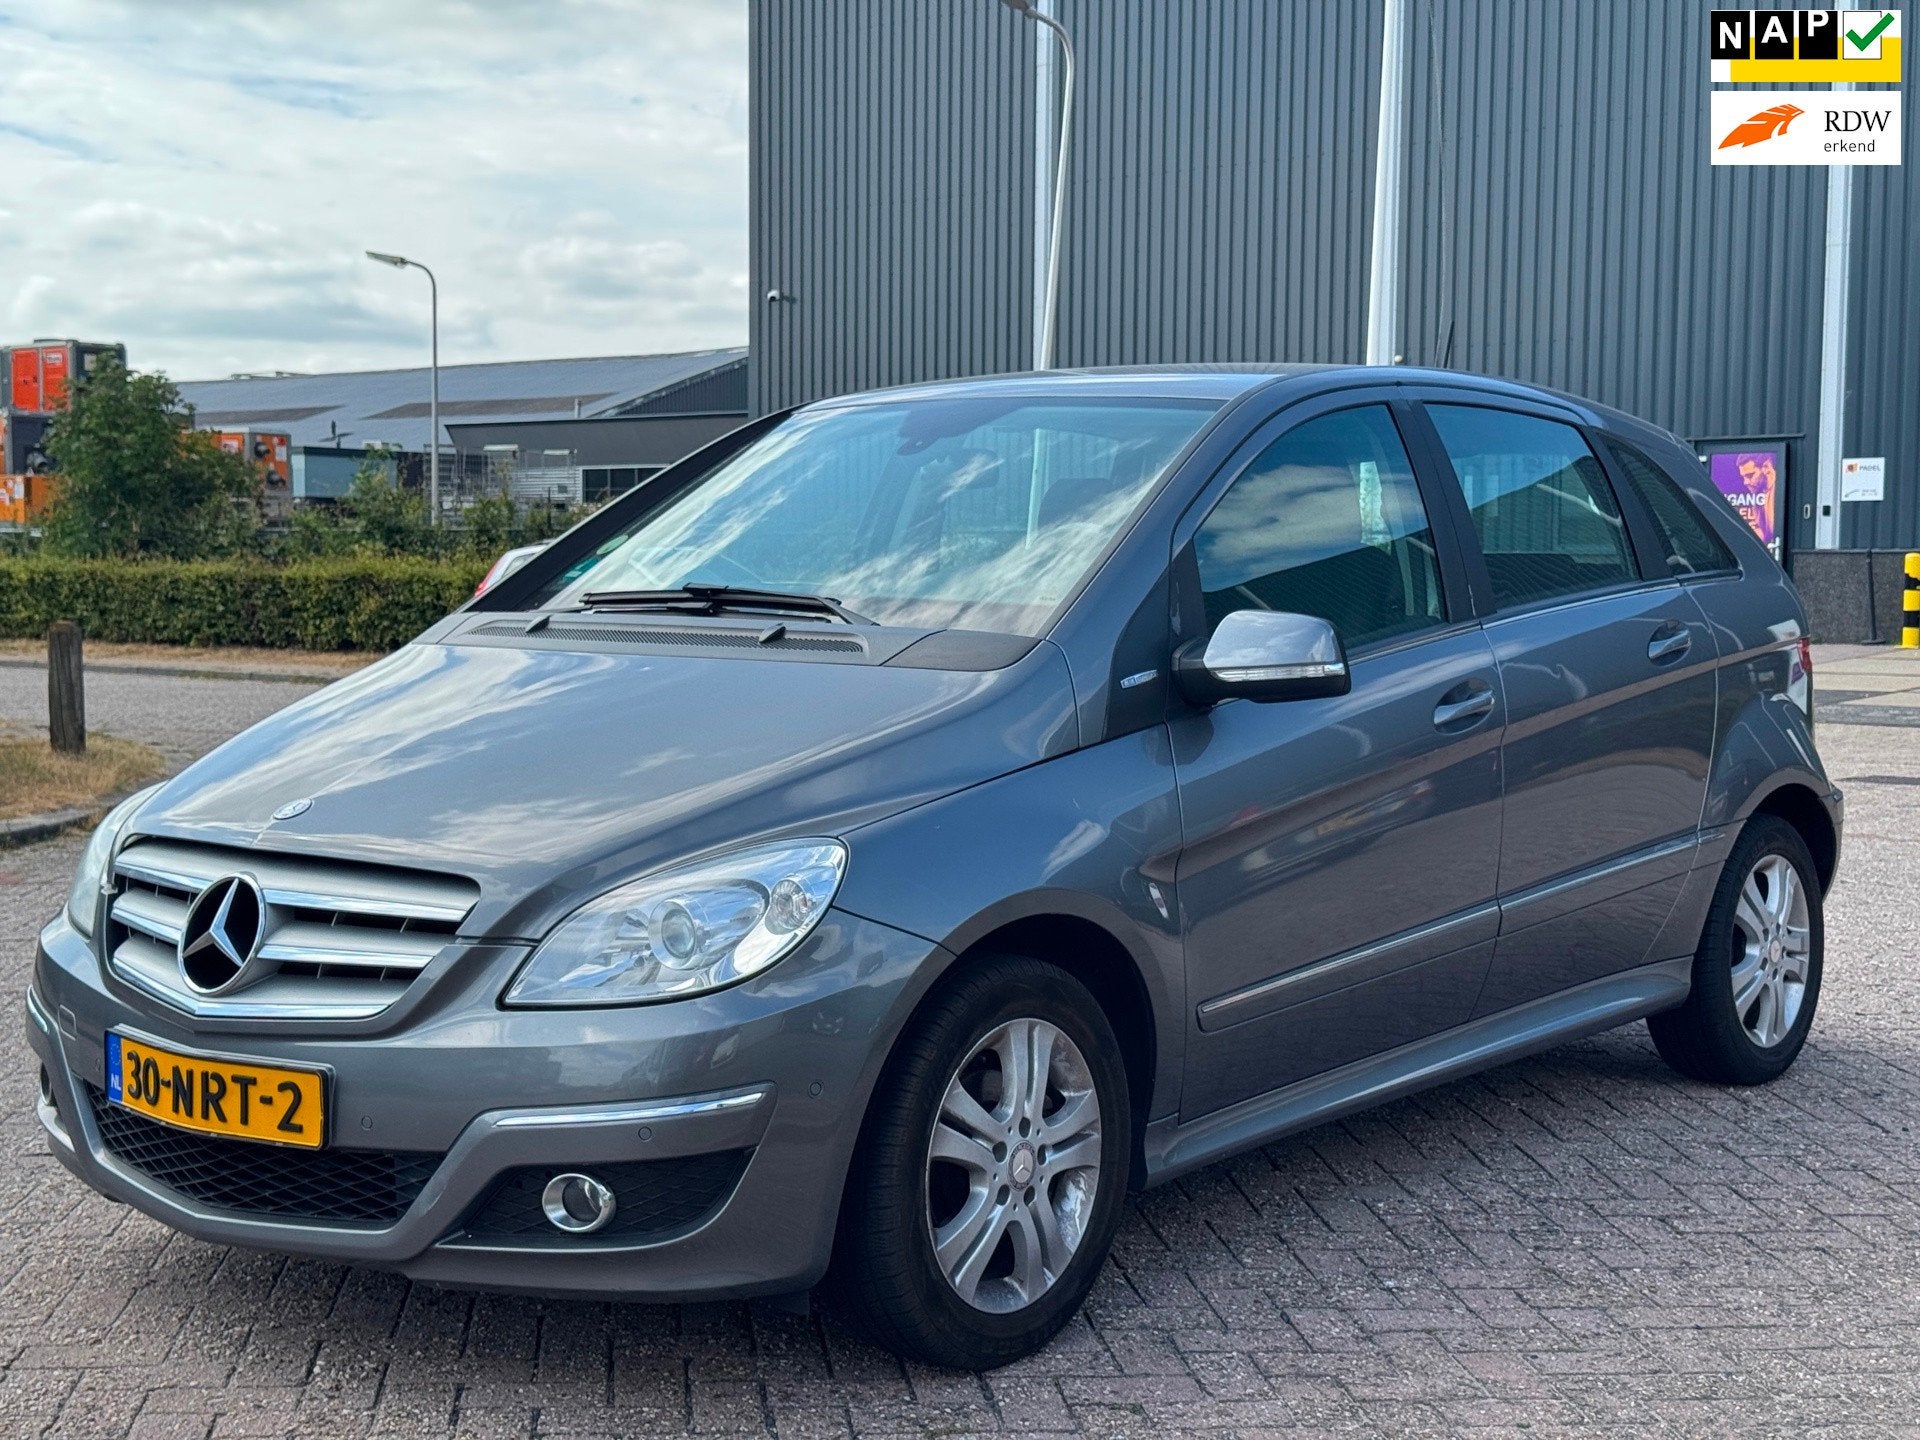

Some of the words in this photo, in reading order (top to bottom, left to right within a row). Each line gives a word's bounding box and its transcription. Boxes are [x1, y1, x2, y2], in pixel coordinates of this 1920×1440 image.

[1724, 493, 1766, 506] GANG
[110, 1073, 122, 1090] NL
[126, 1049, 304, 1134] 30-NRT-2
